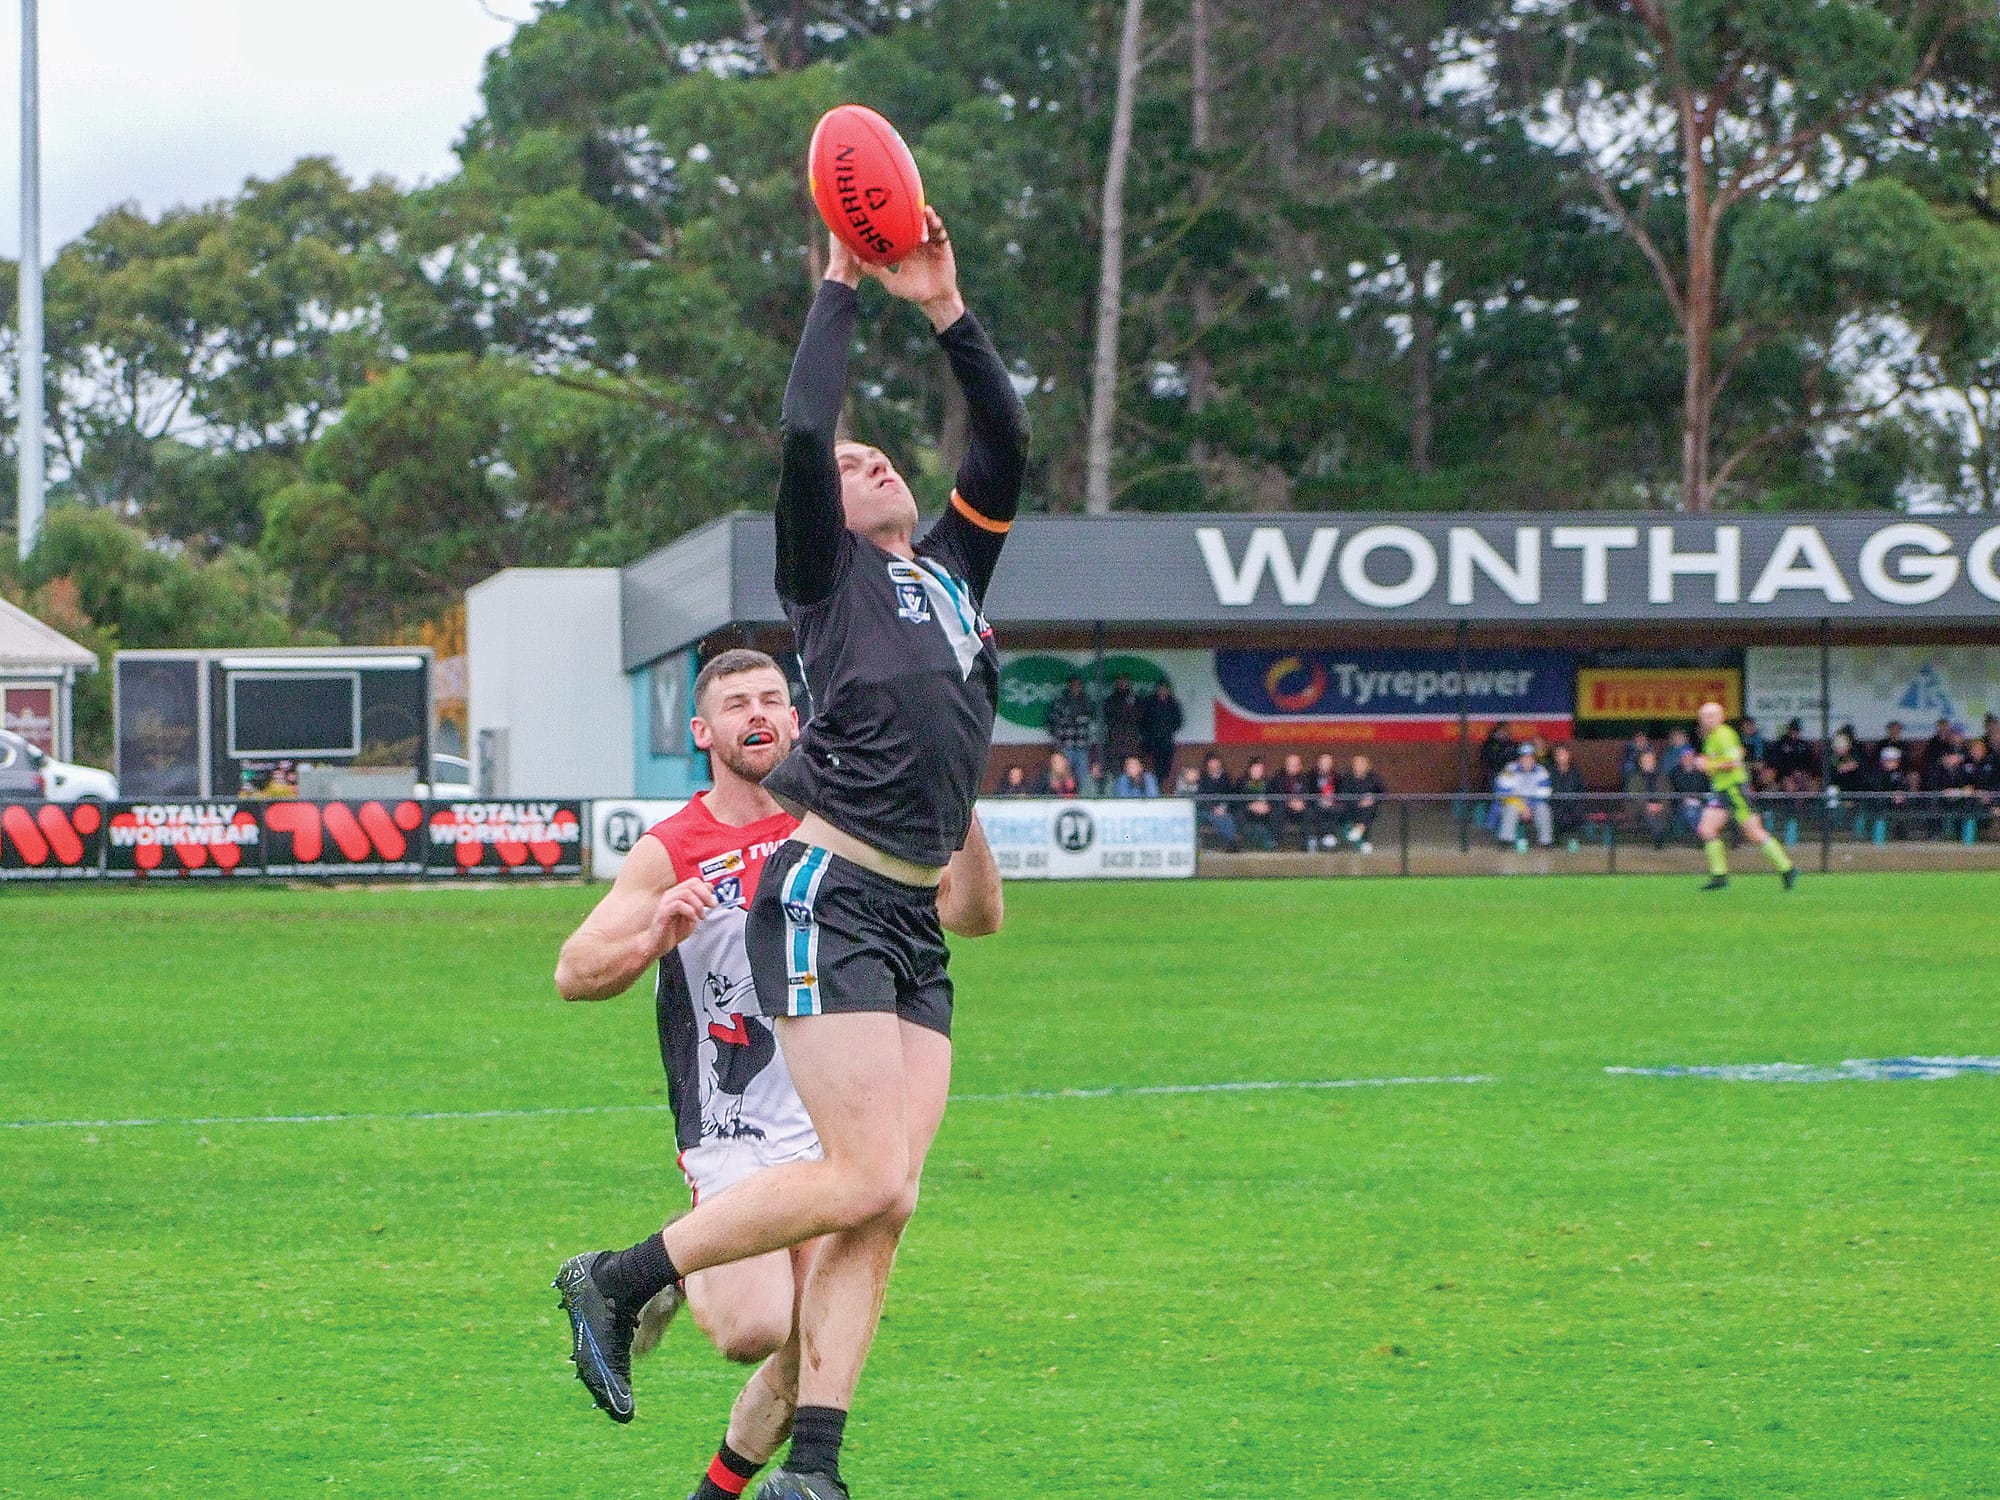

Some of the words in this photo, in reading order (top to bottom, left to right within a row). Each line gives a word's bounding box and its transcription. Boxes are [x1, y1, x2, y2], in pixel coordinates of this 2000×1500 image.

[836, 143, 894, 253] SHERRIN
[1333, 662, 1535, 706] Tyrepower
[131, 804, 238, 826] TOTALLY
[451, 803, 559, 823] TOTALLY
[109, 825, 260, 846] WORKWEAR
[429, 822, 579, 844] WORKWEAR
